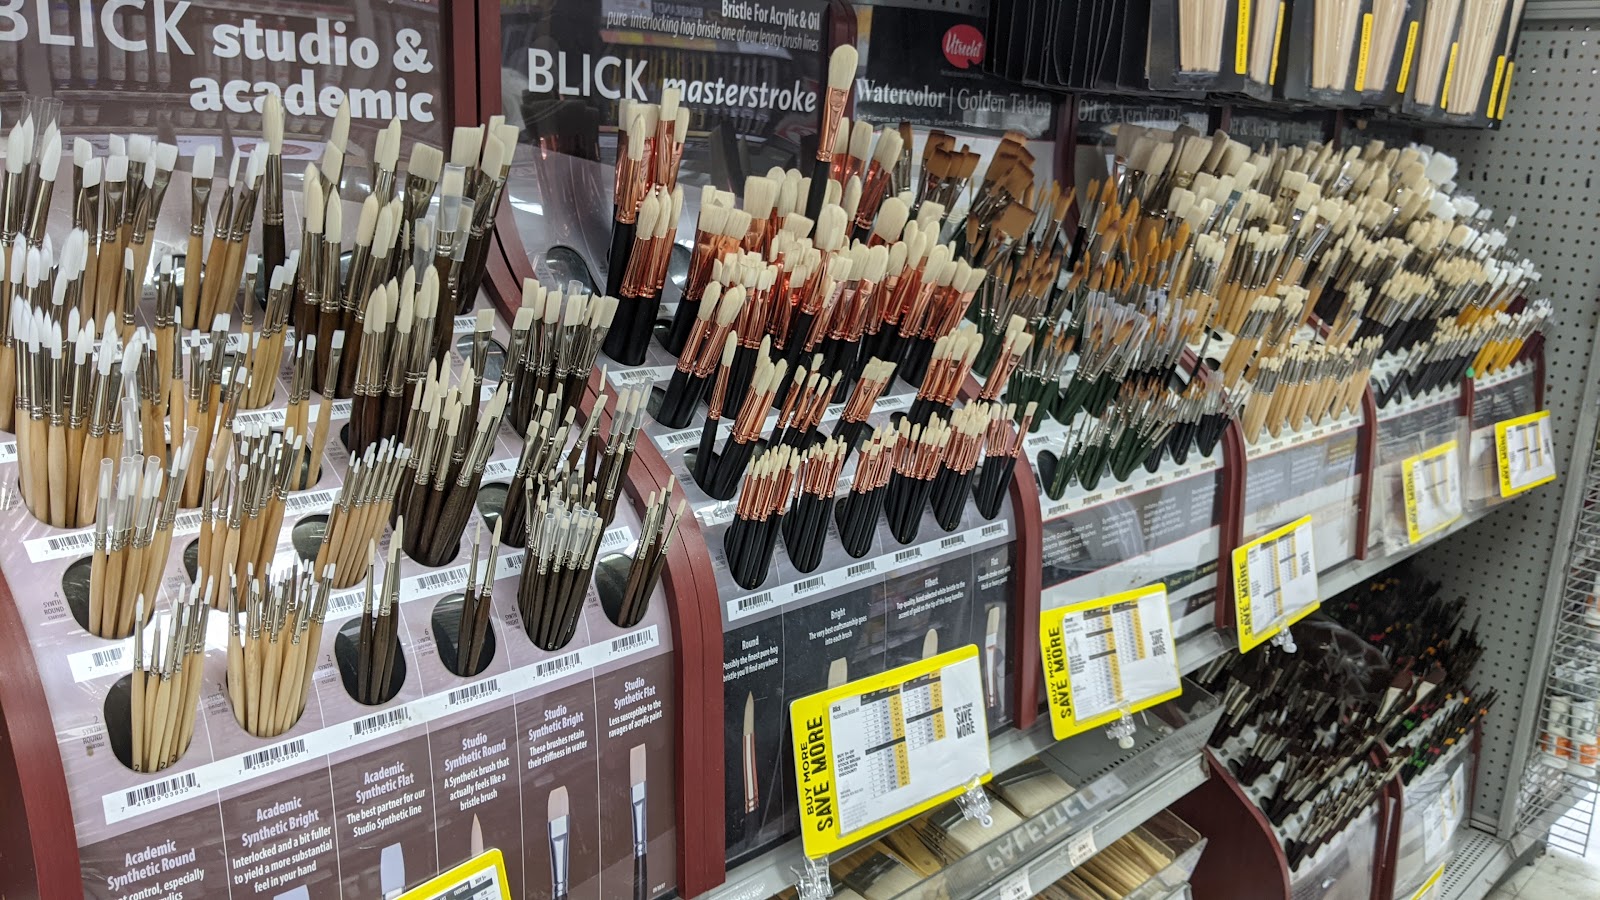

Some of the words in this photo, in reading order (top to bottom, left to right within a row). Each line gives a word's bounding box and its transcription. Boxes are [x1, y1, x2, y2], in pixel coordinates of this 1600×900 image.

[721, 0, 752, 20] Bristle
[754, 4, 769, 23] For
[769, 6, 799, 30] Acrylic
[800, 13, 807, 27] &
[808, 12, 820, 31] Oil
[212, 17, 380, 66] studio
[393, 28, 434, 74] &
[606, 11, 627, 29] pure
[630, 11, 679, 39] interlocking
[680, 19, 695, 40] hog
[697, 20, 721, 39] bristle
[722, 28, 736, 41] one
[737, 28, 745, 42] of
[745, 31, 759, 44] our
[759, 30, 782, 50] legacy
[782, 33, 801, 50] brush
[803, 36, 819, 52] lines
[946, 33, 983, 58] Utrecht
[528, 48, 648, 101] BLICK
[189, 69, 434, 122] academic
[855, 78, 945, 108] Watercolor
[957, 88, 1006, 113] Golden
[1010, 93, 1051, 116] Taklon
[1077, 99, 1097, 122] Oil
[925, 577, 939, 588] Filbert
[43, 599, 62, 608] SYNTH
[43, 606, 65, 616] ROUND
[831, 607, 846, 620] Bright
[741, 635, 760, 650] Round
[841, 629, 853, 640] brush
[722, 658, 740, 670] Possibly
[740, 655, 748, 665] the
[748, 651, 760, 662] finest
[760, 648, 770, 660] pure
[769, 645, 779, 655] hog
[1048, 626, 1064, 674] MORE
[722, 670, 737, 682] bristle
[757, 657, 779, 670] anywhere
[613, 690, 644, 711] Synthetic
[643, 685, 656, 699] Flat
[624, 677, 645, 693] Studio
[1057, 678, 1072, 719] SAVE
[528, 719, 562, 743] Synthetic
[561, 711, 584, 728] Bright
[544, 704, 567, 722] Studio
[608, 717, 620, 727] Less
[619, 704, 648, 723] susceptible
[652, 699, 662, 710] the
[608, 724, 629, 739] ravages
[634, 714, 650, 728] acrylic
[649, 709, 663, 724] paint
[955, 708, 973, 726] SAVE
[82, 734, 103, 745] ROUND
[462, 732, 488, 751] Studio
[529, 744, 547, 757] These
[546, 735, 568, 751] brushes
[568, 728, 585, 743] retain
[806, 714, 828, 776] MORE
[956, 721, 976, 740] MORE
[444, 748, 482, 772] Synthetic
[481, 738, 507, 757] Round
[527, 756, 542, 769] their
[542, 748, 566, 765] stiffness
[565, 745, 572, 755] in
[571, 740, 588, 753] water
[800, 741, 811, 783] MORE
[363, 760, 405, 786] Academic
[449, 768, 479, 788] Synthetic
[478, 761, 496, 776] brush
[496, 756, 510, 769] that
[449, 783, 475, 801] actually
[474, 777, 490, 791] feels
[489, 773, 502, 786] like
[355, 778, 398, 805] Synthetic
[397, 772, 415, 788] Flat
[460, 795, 481, 812] bristle
[480, 788, 498, 804] brush
[807, 786, 815, 816] BUY
[256, 796, 303, 823] Academic
[346, 812, 361, 825] The
[360, 806, 377, 820] best
[376, 797, 403, 816] partner
[403, 792, 414, 804] for
[413, 788, 426, 800] our
[812, 780, 834, 832] SAVE
[241, 820, 288, 848] Synthetic
[288, 808, 320, 830] Bright
[353, 821, 377, 838] Studio
[376, 807, 409, 830] Synthetic
[408, 805, 422, 817] line
[125, 838, 177, 868] Academic
[232, 844, 277, 870] Interlocked
[277, 837, 293, 853] and
[298, 832, 311, 846] bit
[310, 826, 332, 841] fuller
[234, 874, 244, 885] to
[243, 864, 264, 884] yield
[270, 857, 291, 872] more
[291, 838, 333, 864] substantial
[107, 861, 161, 892] Synthetic
[160, 847, 197, 872] Round
[128, 882, 163, 900] control,
[163, 867, 205, 891] especially
[254, 878, 270, 894] feel
[270, 876, 280, 887] in
[279, 869, 297, 886] your
[297, 859, 317, 877] hand
